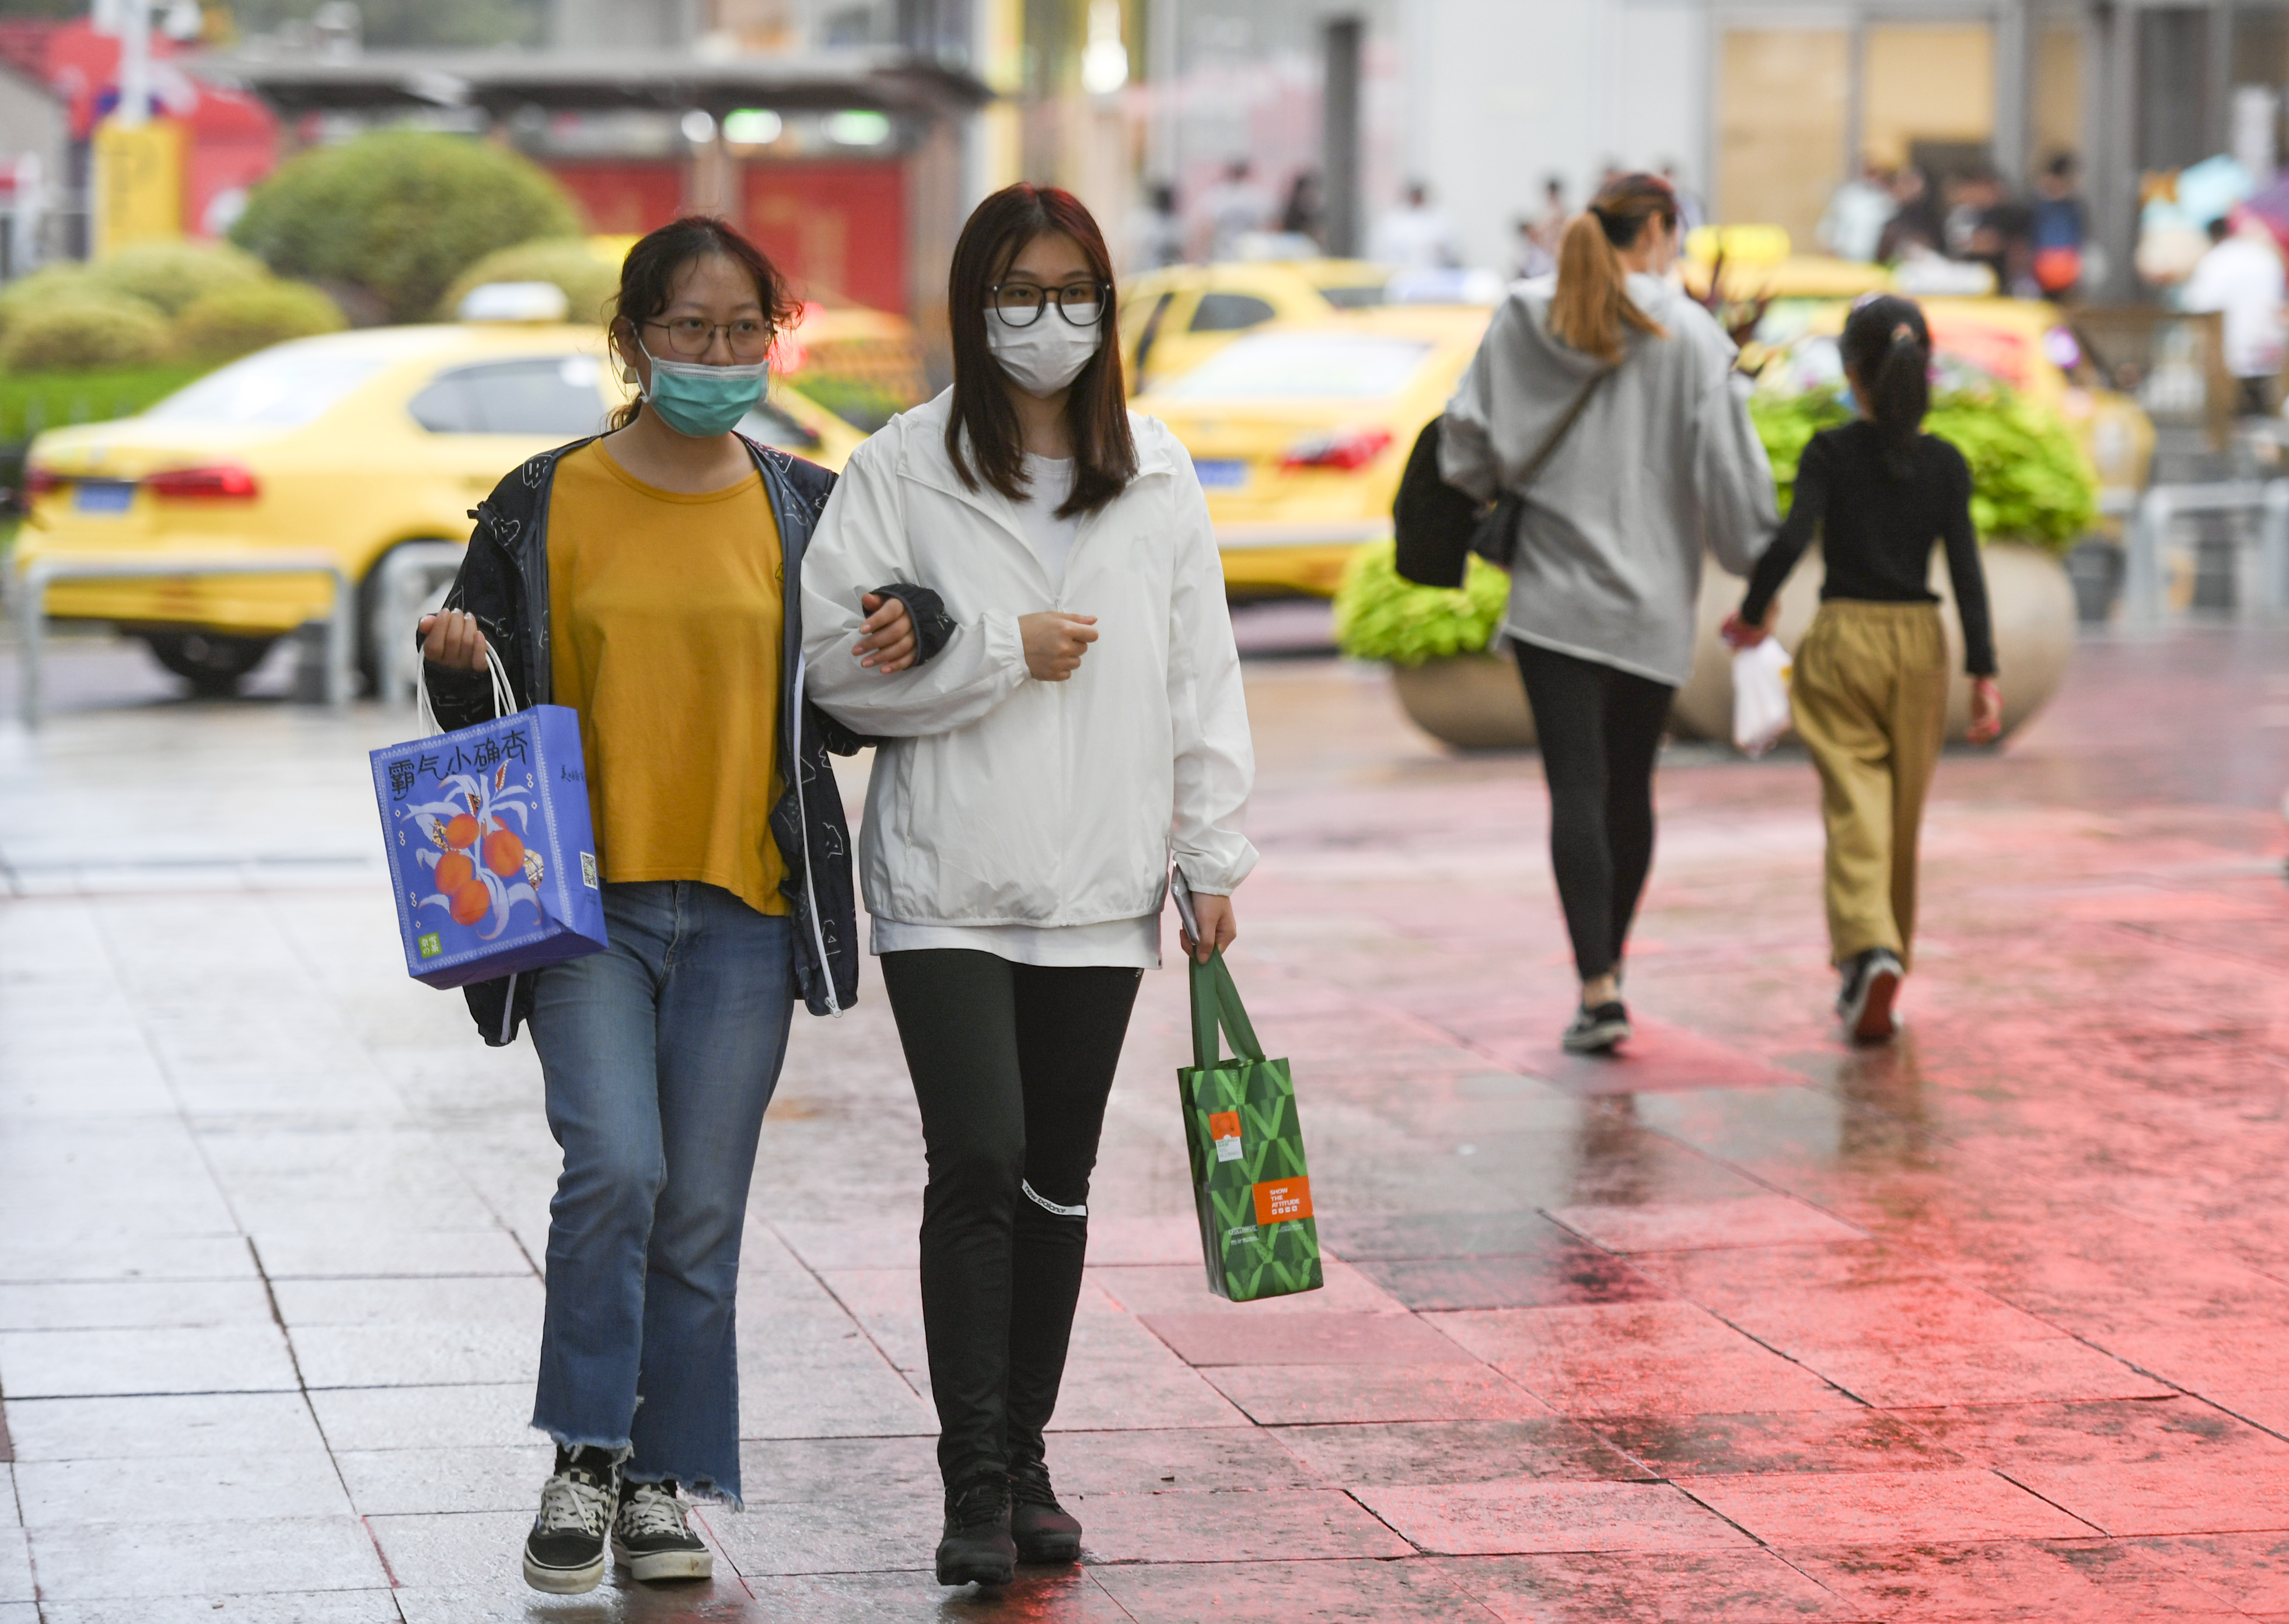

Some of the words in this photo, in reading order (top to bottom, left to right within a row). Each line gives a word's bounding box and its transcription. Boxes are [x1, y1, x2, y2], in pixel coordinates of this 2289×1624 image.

[1270, 1187, 1288, 1195] SHOW
[1025, 1186, 1037, 1200] new
[1038, 1197, 1066, 1213] balance
[1271, 1198, 1300, 1208] ATTITUDE
